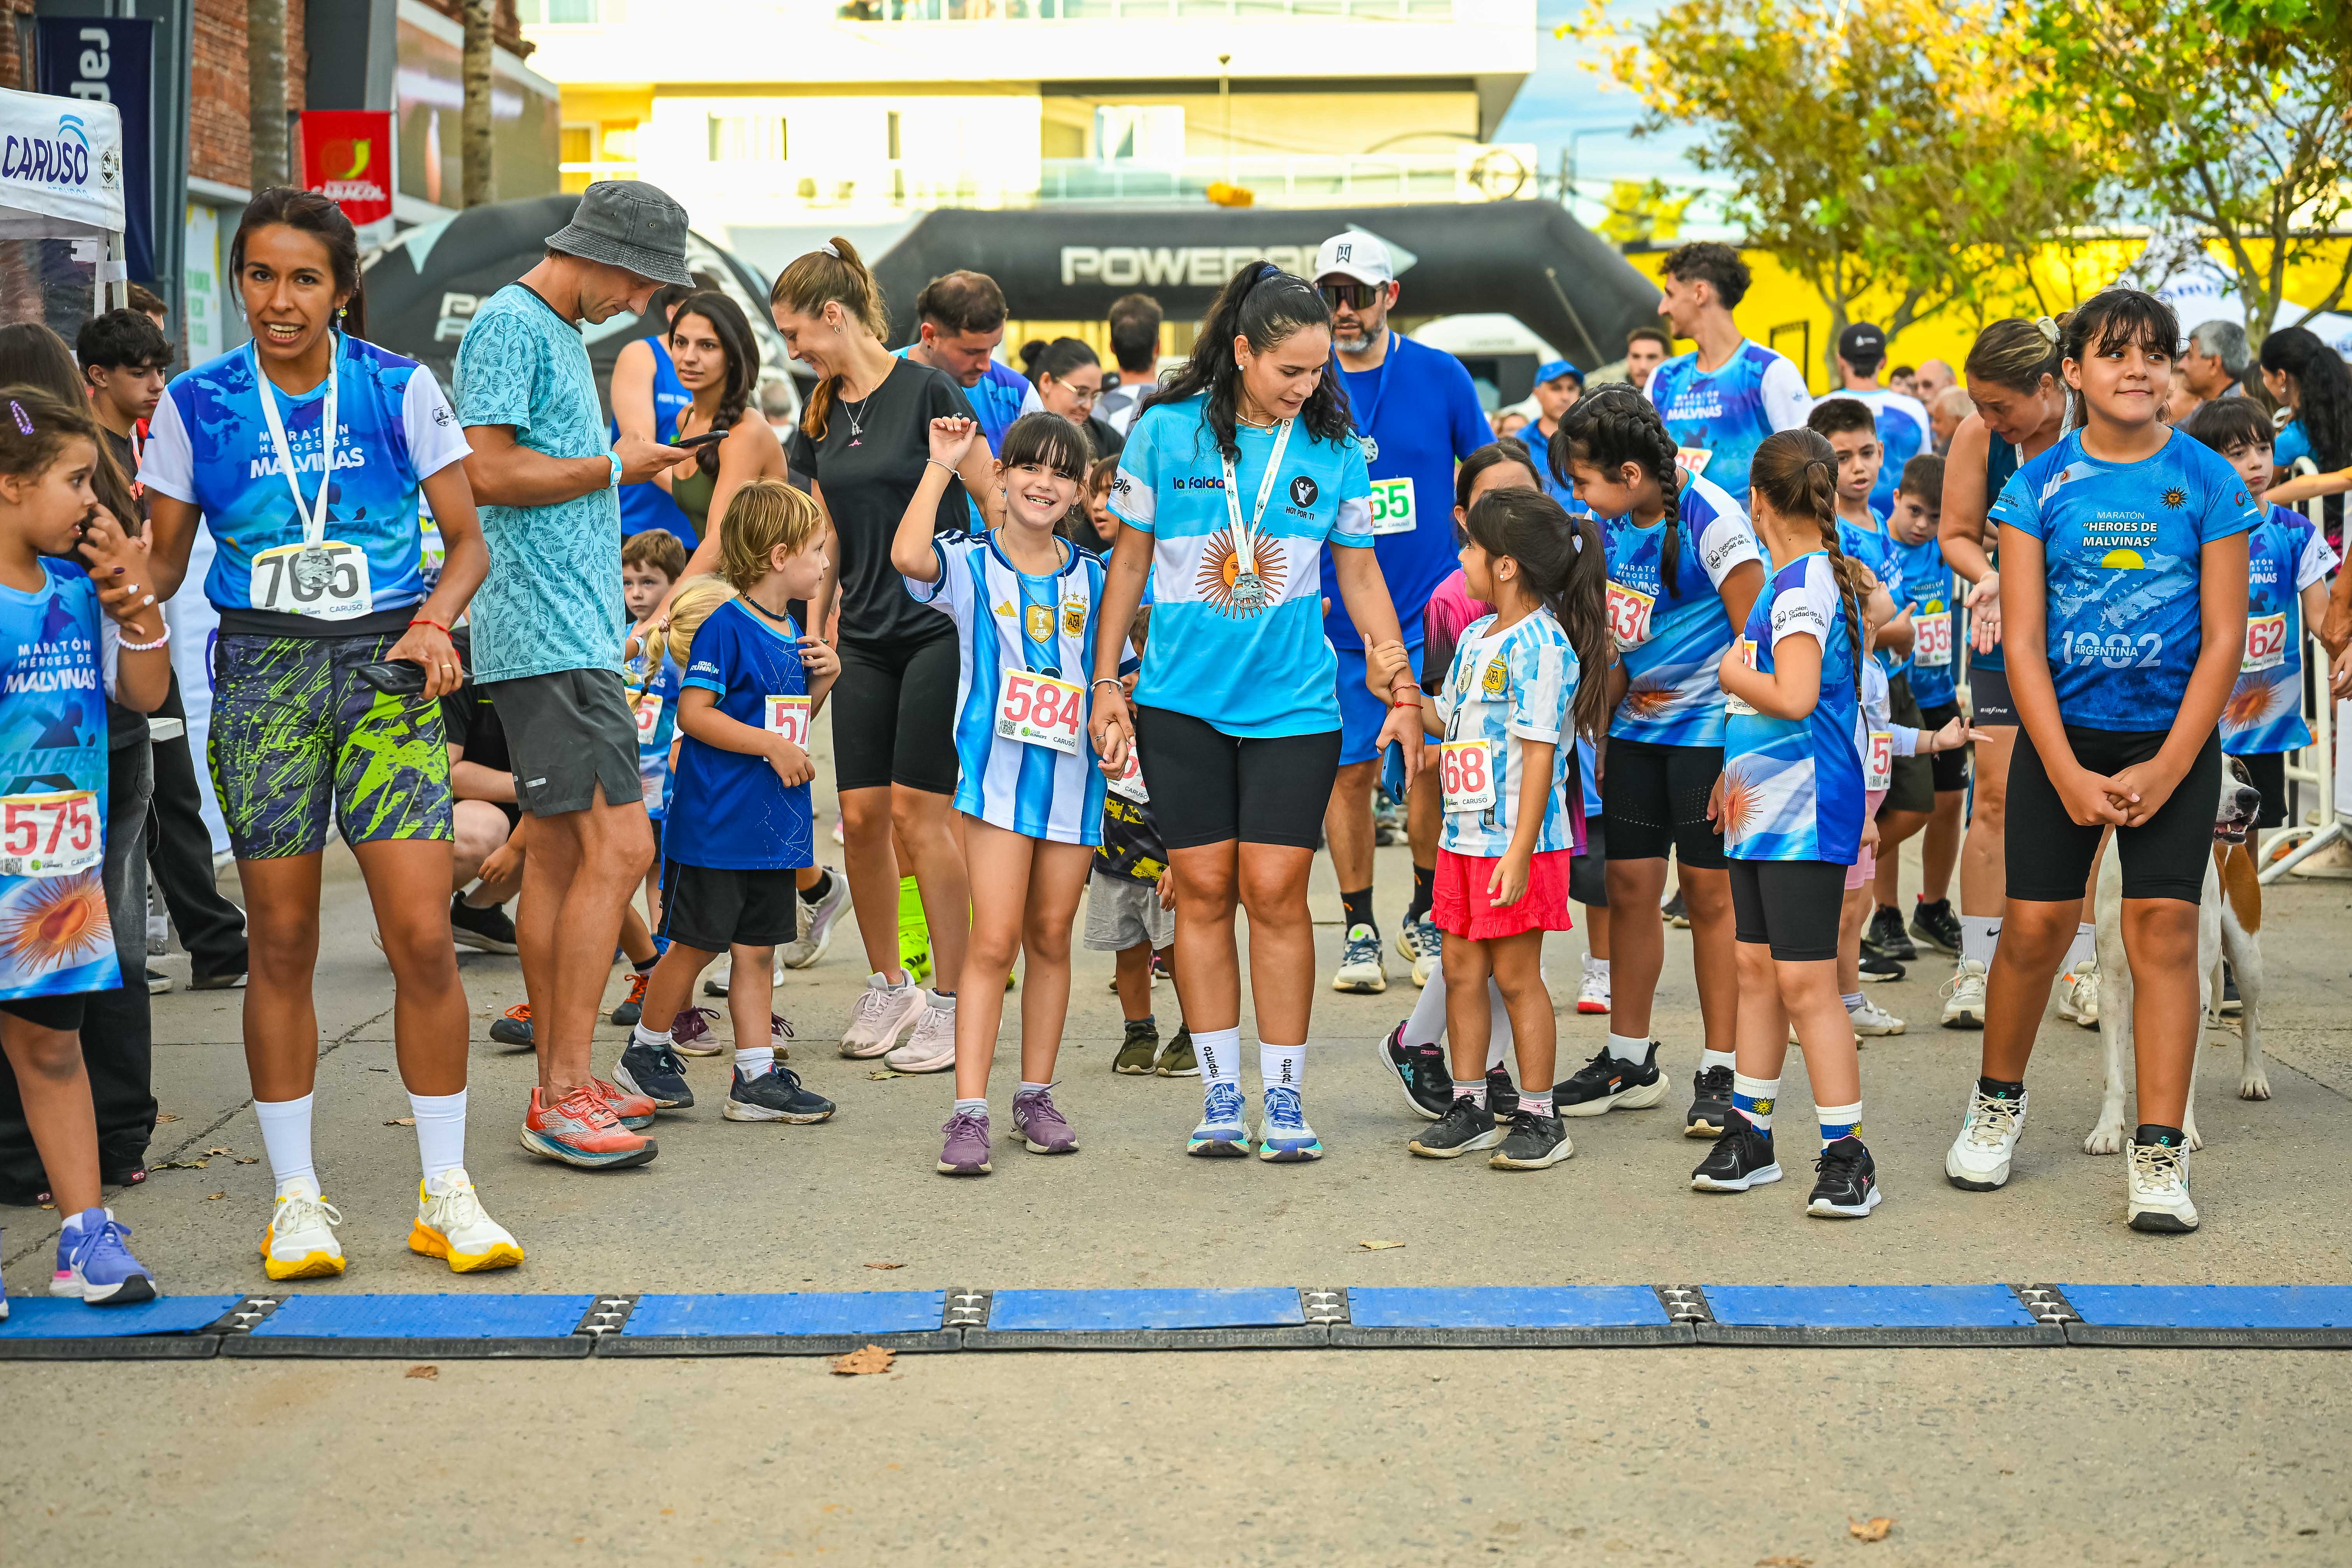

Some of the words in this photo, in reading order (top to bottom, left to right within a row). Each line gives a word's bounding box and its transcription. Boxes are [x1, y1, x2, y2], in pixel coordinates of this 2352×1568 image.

[2, 135, 88, 185] CARUSO
[259, 424, 348, 442] MRATN
[1112, 473, 1131, 495] ale
[1173, 477, 1185, 490] la
[1188, 476, 1225, 489] falda
[1286, 506, 1297, 515] HOY
[1297, 509, 1307, 518] POR
[2097, 511, 2144, 520] MARATÓN
[2141, 523, 2158, 532] DE
[1616, 570, 1649, 579] HÉROES
[330, 604, 362, 612] CARUSO
[1605, 589, 1650, 642] 531
[1068, 613, 1080, 629] AFA
[2249, 620, 2284, 658] 62
[18, 637, 91, 657] MARATÓN
[2074, 645, 2139, 657] ARGENTINA
[18, 654, 71, 668] HÉROES
[77, 653, 91, 664] DE
[4, 667, 96, 694] MALVINAS
[1486, 669, 1499, 684] AFA
[1004, 676, 1080, 735] 584
[776, 703, 810, 744] 57
[1053, 737, 1074, 747] CARUSO
[1125, 786, 1148, 799] CARUSO
[5, 796, 92, 856] 575
